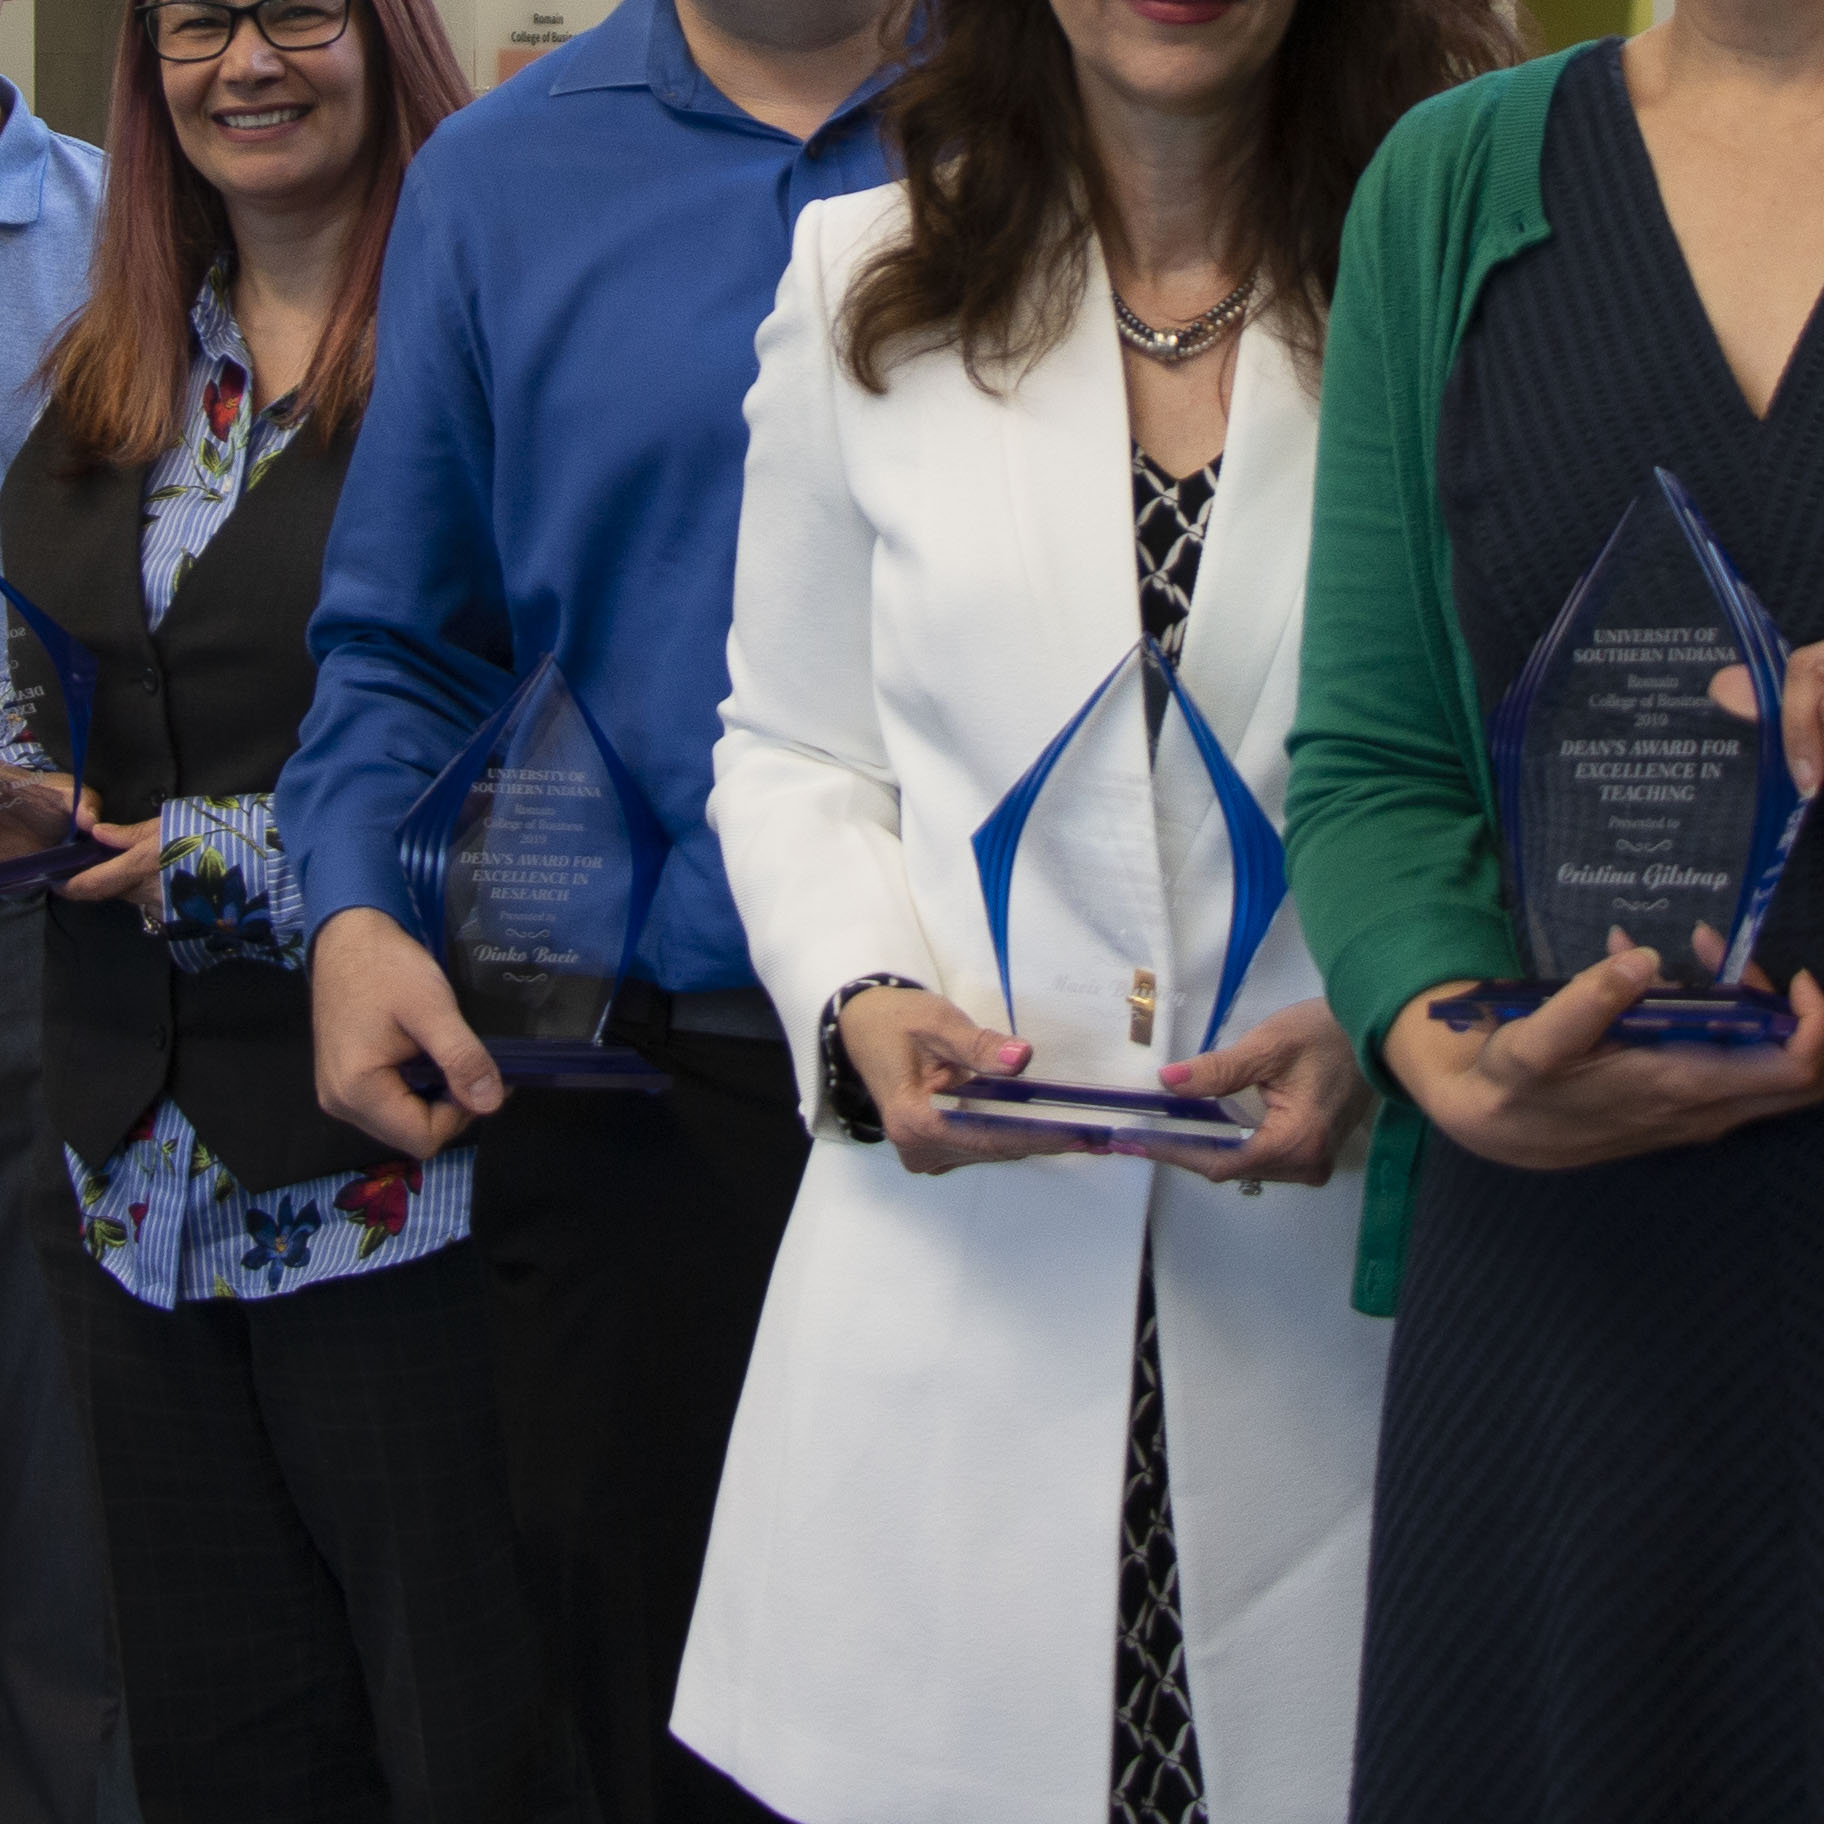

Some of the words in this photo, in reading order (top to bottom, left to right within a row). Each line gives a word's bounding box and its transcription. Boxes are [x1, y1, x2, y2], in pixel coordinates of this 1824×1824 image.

[533, 12, 564, 25] Romain
[511, 31, 541, 46] College
[542, 31, 551, 43] of
[1593, 628, 1692, 643] UNIVERSITY
[1694, 627, 1718, 643] OF
[1573, 647, 1664, 663] SOUTHERN
[1666, 647, 1738, 662] INDIANA
[1627, 674, 1679, 689] Romain
[1587, 693, 1637, 711] College
[1639, 692, 1656, 708] of
[1559, 739, 1628, 757] DEAN'S
[1629, 739, 1698, 757] AWARD
[1700, 739, 1742, 756] FOR
[487, 767, 565, 781] UNIVERSITY
[567, 770, 586, 782] OF
[1574, 761, 1697, 779] EXCELLENCE
[1699, 762, 1724, 779] IN
[471, 781, 544, 795] SOUTHERN
[546, 784, 601, 798] INDIANA
[1600, 784, 1697, 802] TEACHING
[1608, 814, 1666, 829] Presented
[1667, 816, 1681, 829] to
[460, 851, 514, 866] DEAN'S
[516, 853, 570, 868] AWARD
[572, 855, 604, 869] FOR
[472, 868, 570, 885] EXCELLENCE
[572, 872, 590, 885] IN
[1556, 861, 1638, 885] Cristina
[1641, 862, 1731, 891] Gilstrap
[490, 886, 571, 902] RESEARCH
[472, 944, 528, 963] Dinko
